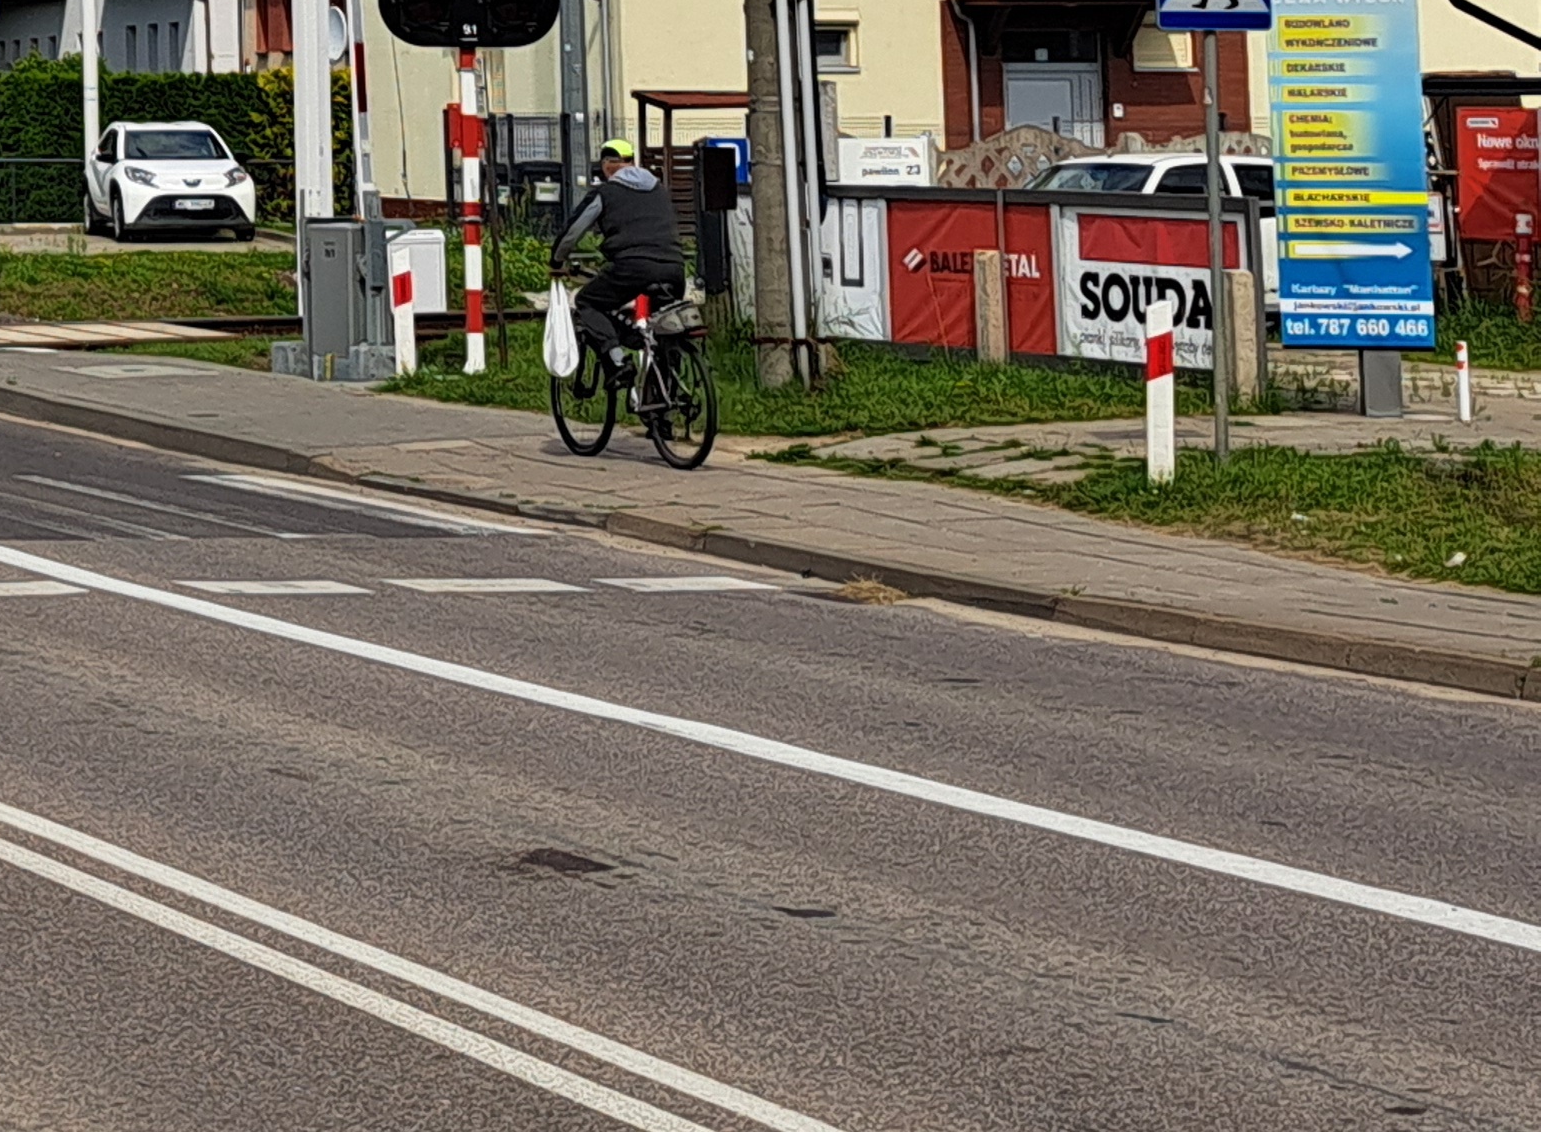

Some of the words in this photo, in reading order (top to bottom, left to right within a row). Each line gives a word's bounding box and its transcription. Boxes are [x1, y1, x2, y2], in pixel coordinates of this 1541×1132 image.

[1477, 132, 1513, 149] Nowe
[929, 249, 974, 274] BALE
[1286, 319, 1316, 336] tel.
[1318, 319, 1350, 336] 787
[1356, 319, 1390, 337] 660
[1395, 320, 1429, 337] 466
